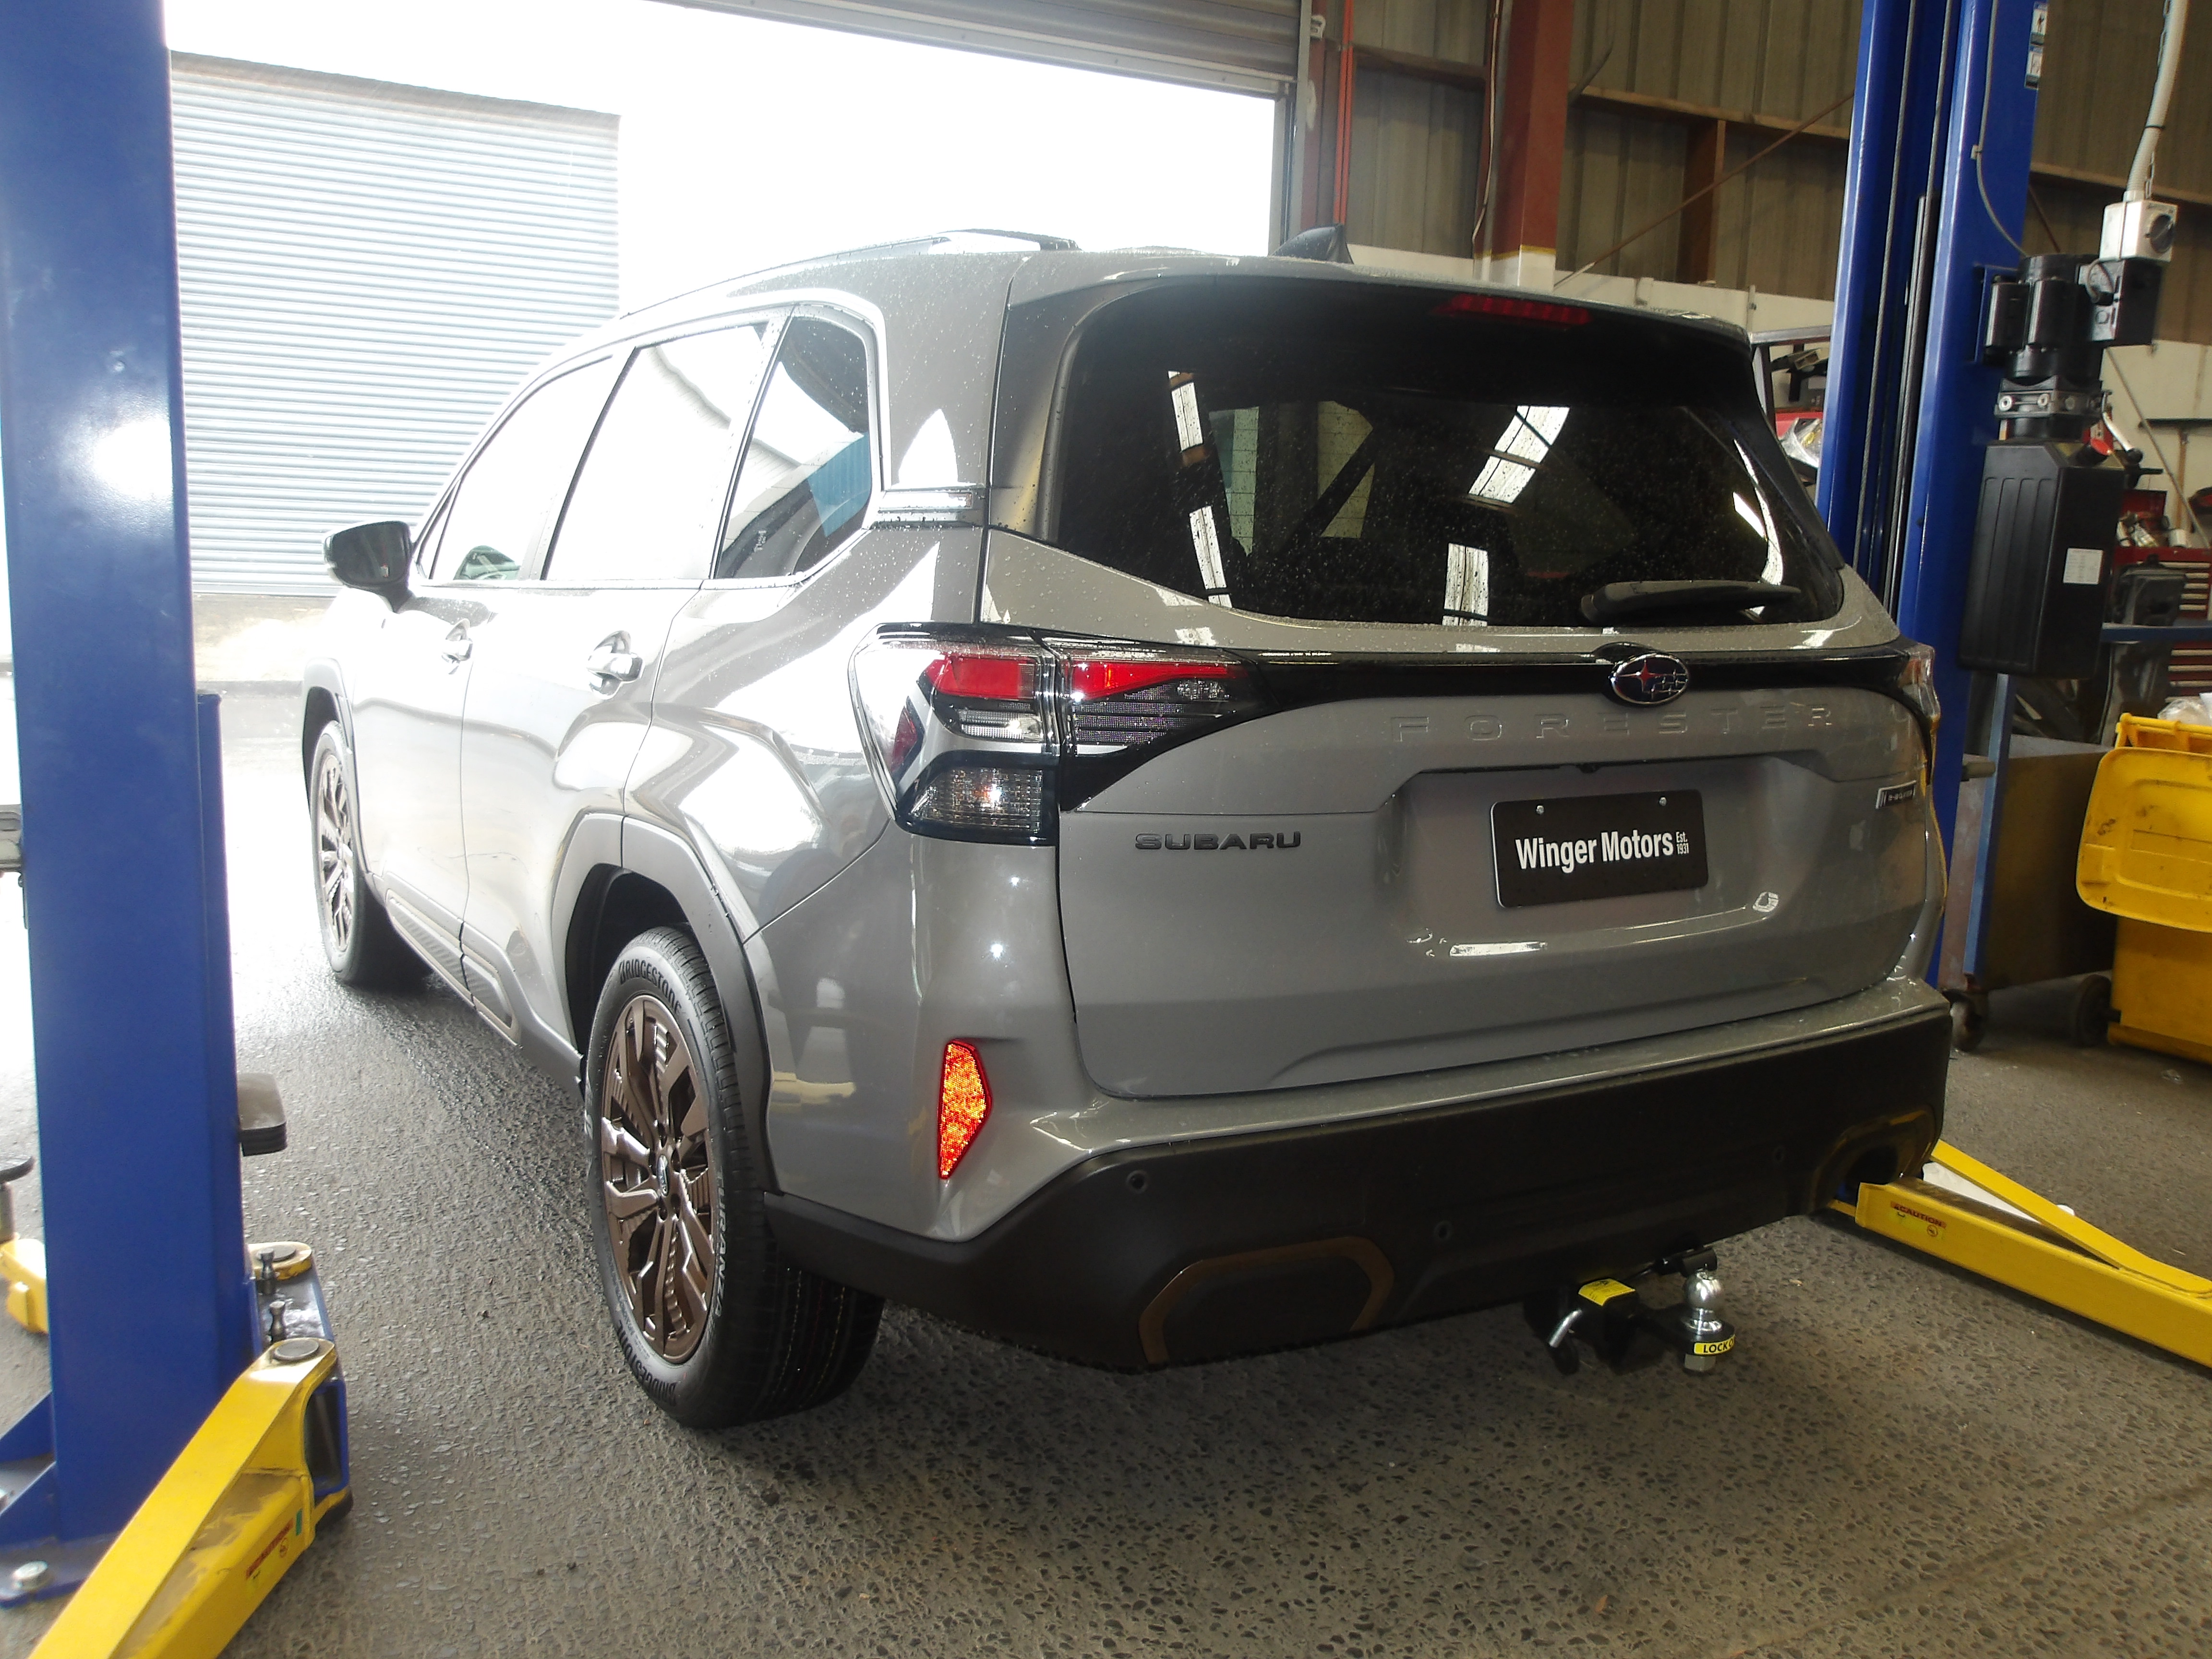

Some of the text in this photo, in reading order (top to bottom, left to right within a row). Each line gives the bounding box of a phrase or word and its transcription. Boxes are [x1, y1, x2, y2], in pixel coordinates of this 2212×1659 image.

[1391, 704, 1833, 742] FORESTER
[1135, 831, 1301, 850] SUBARU
[1676, 831, 1687, 842] Est.
[1515, 830, 1674, 874] Winger Motors
[1676, 842, 1689, 854] 1931
[619, 959, 682, 1014] BRIDGESTONE
[1899, 1206, 1942, 1226] CAUTION
[1703, 1341, 1728, 1353] LOCK
